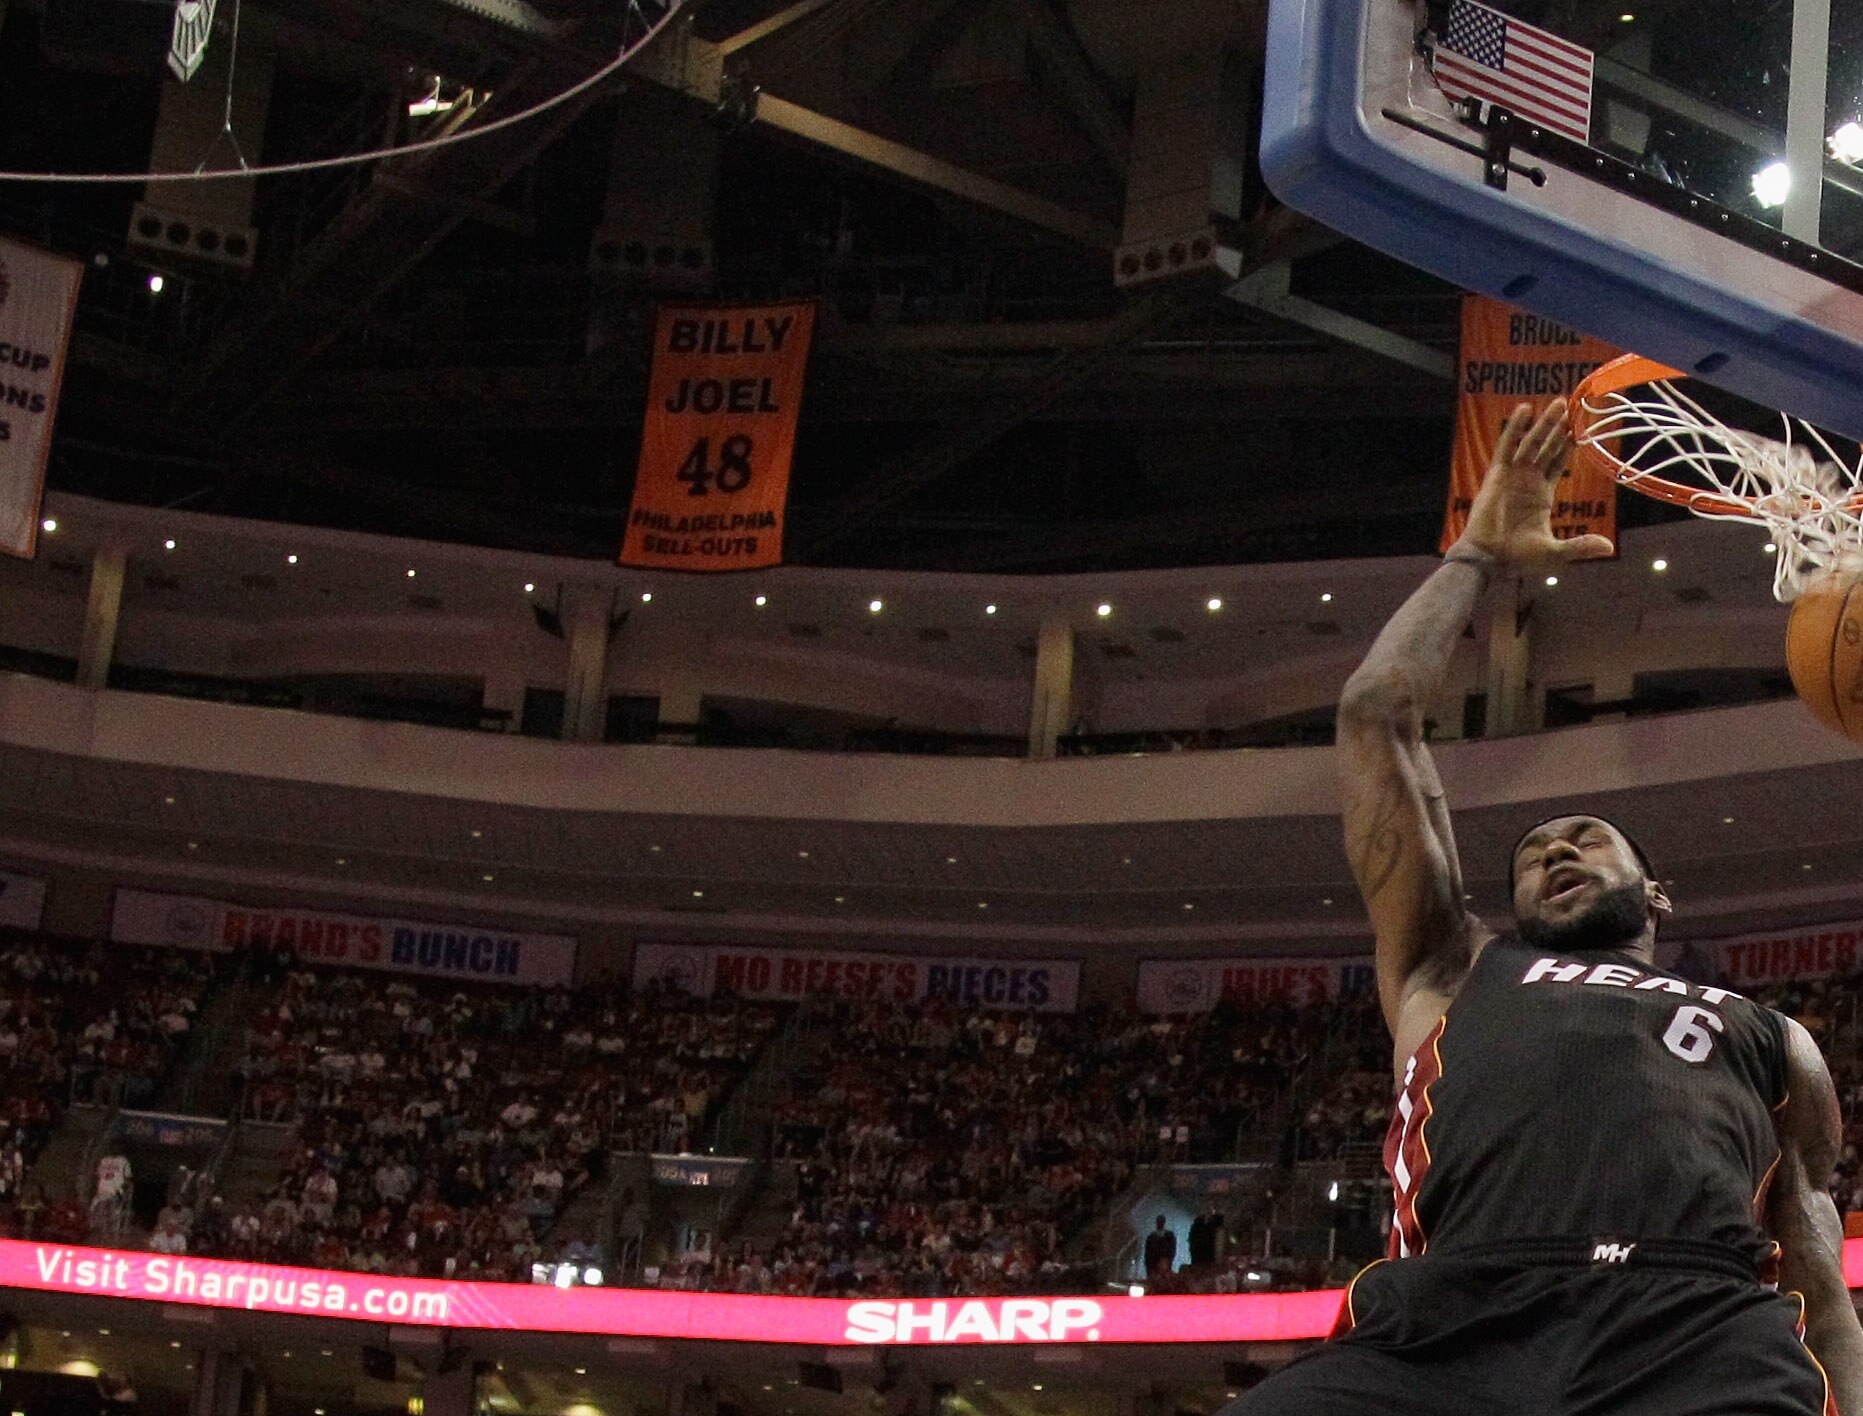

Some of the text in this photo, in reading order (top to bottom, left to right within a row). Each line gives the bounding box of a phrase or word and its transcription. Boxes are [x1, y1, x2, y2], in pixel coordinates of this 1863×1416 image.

[668, 316, 795, 354] BILLY
[665, 377, 779, 414] JOEL
[676, 433, 754, 496] 48
[631, 509, 777, 532] PHILADELPHIA
[390, 923, 520, 978] BUNCH
[1521, 957, 1744, 1006] HEAT
[1662, 1005, 1725, 1063] 6
[36, 1248, 449, 1318] Visit Sharpusa.com
